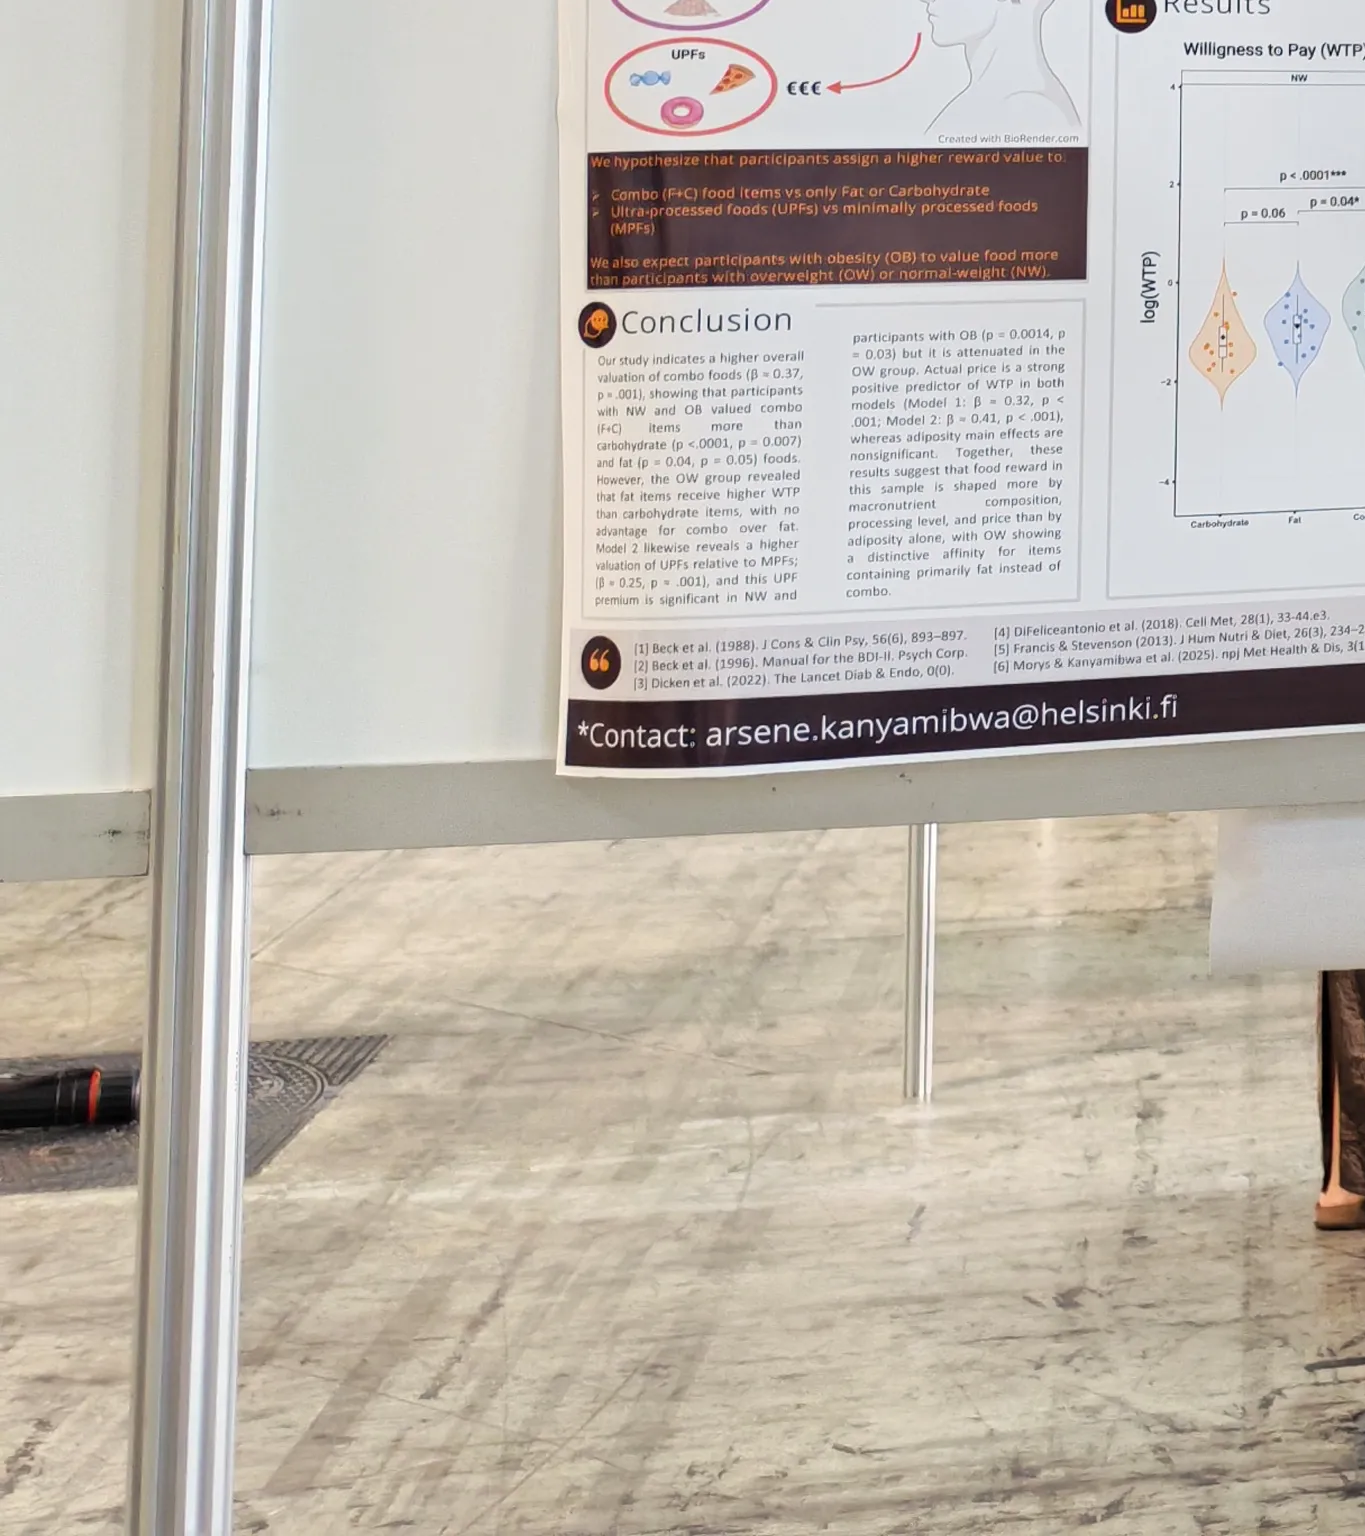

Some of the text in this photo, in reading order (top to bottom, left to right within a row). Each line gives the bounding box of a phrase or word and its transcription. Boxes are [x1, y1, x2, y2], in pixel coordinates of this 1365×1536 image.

[671, 48, 706, 60] UPFs
[1140, 252, 1160, 323] log(WTP)
[622, 308, 791, 334] Conclusion
[847, 527, 1062, 549] adiposity alone, with OW showing
